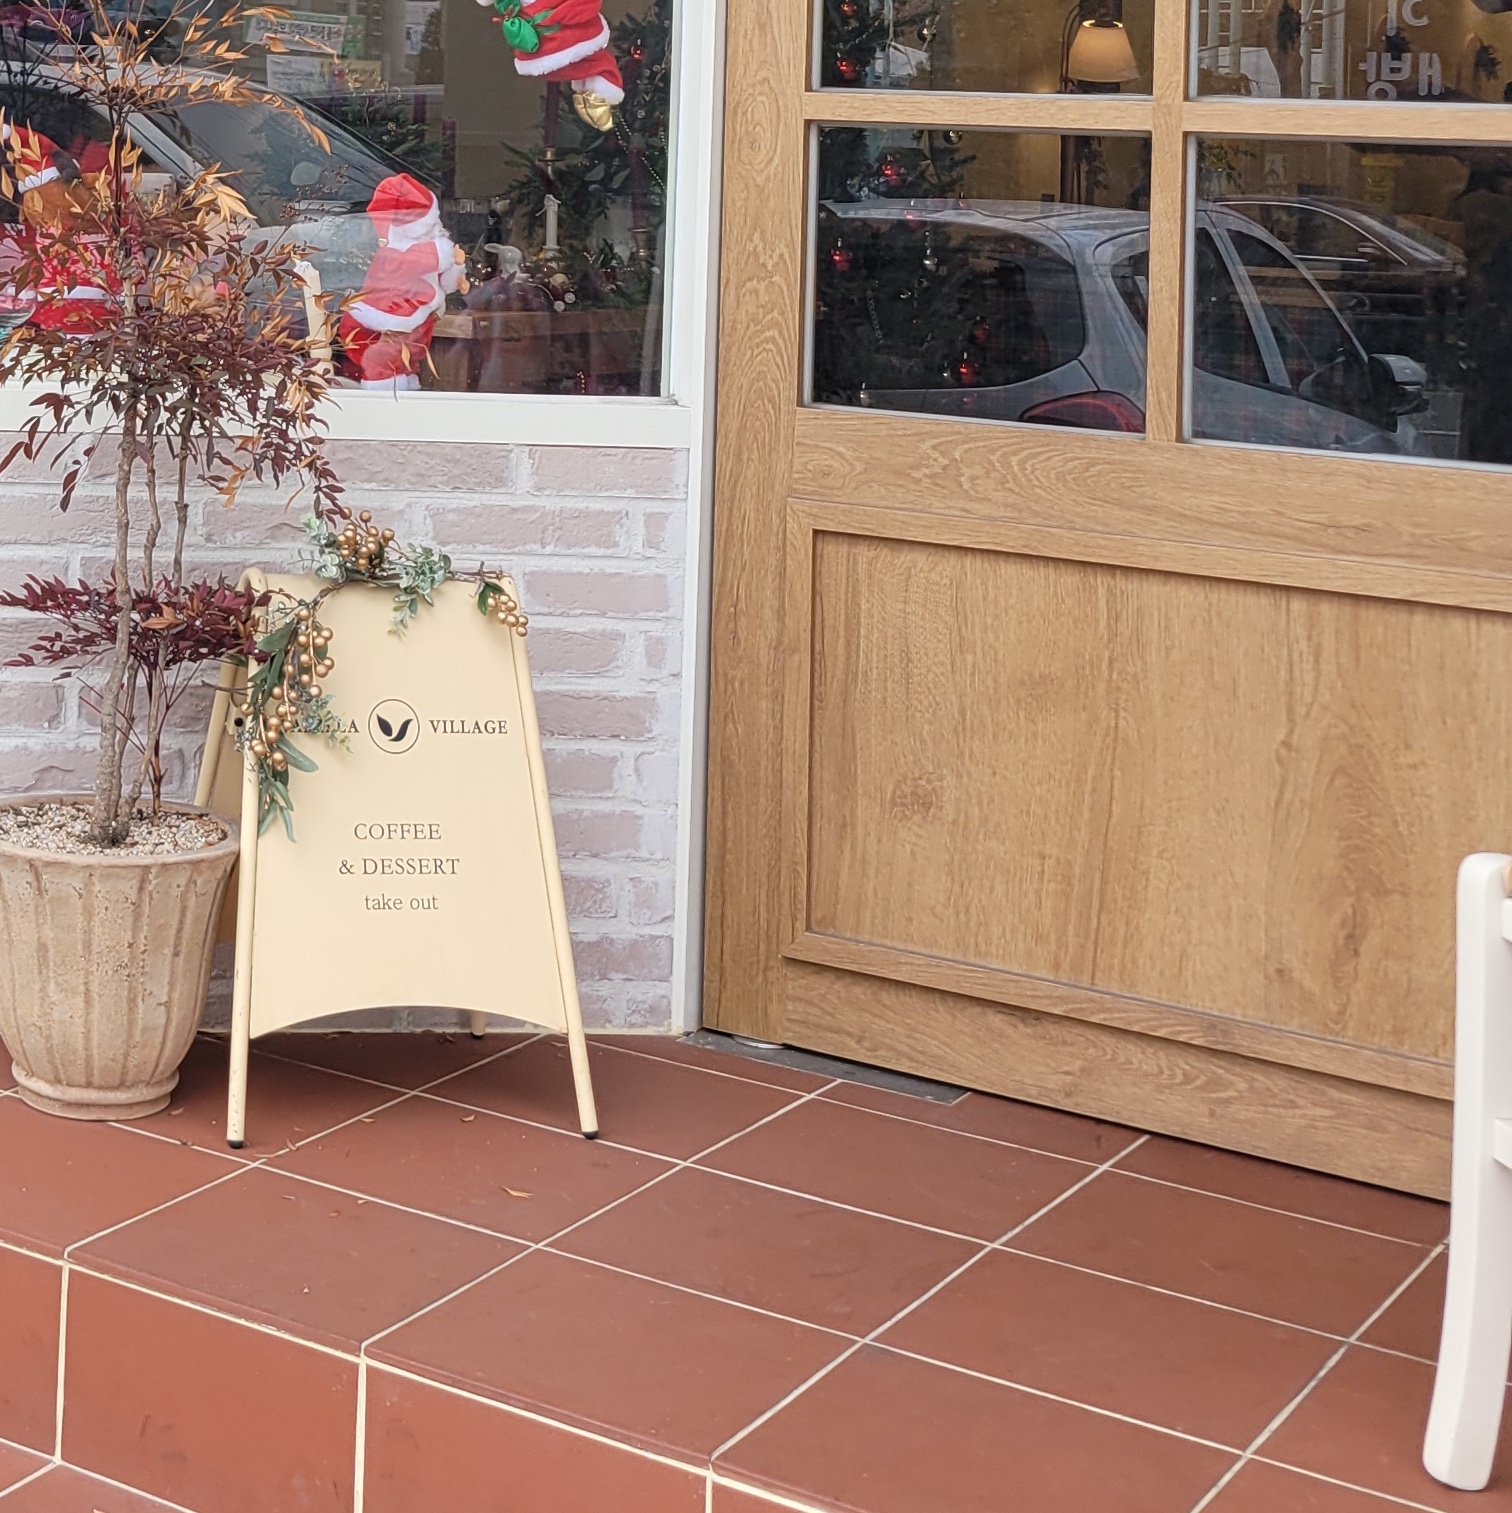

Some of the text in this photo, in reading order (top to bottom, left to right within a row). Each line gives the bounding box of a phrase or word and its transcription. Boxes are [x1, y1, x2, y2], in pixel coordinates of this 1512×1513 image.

[429, 719, 508, 735] VILLAGE
[354, 823, 442, 840] COFFEE
[339, 858, 460, 875] & DESSERT
[365, 893, 439, 910] take out
